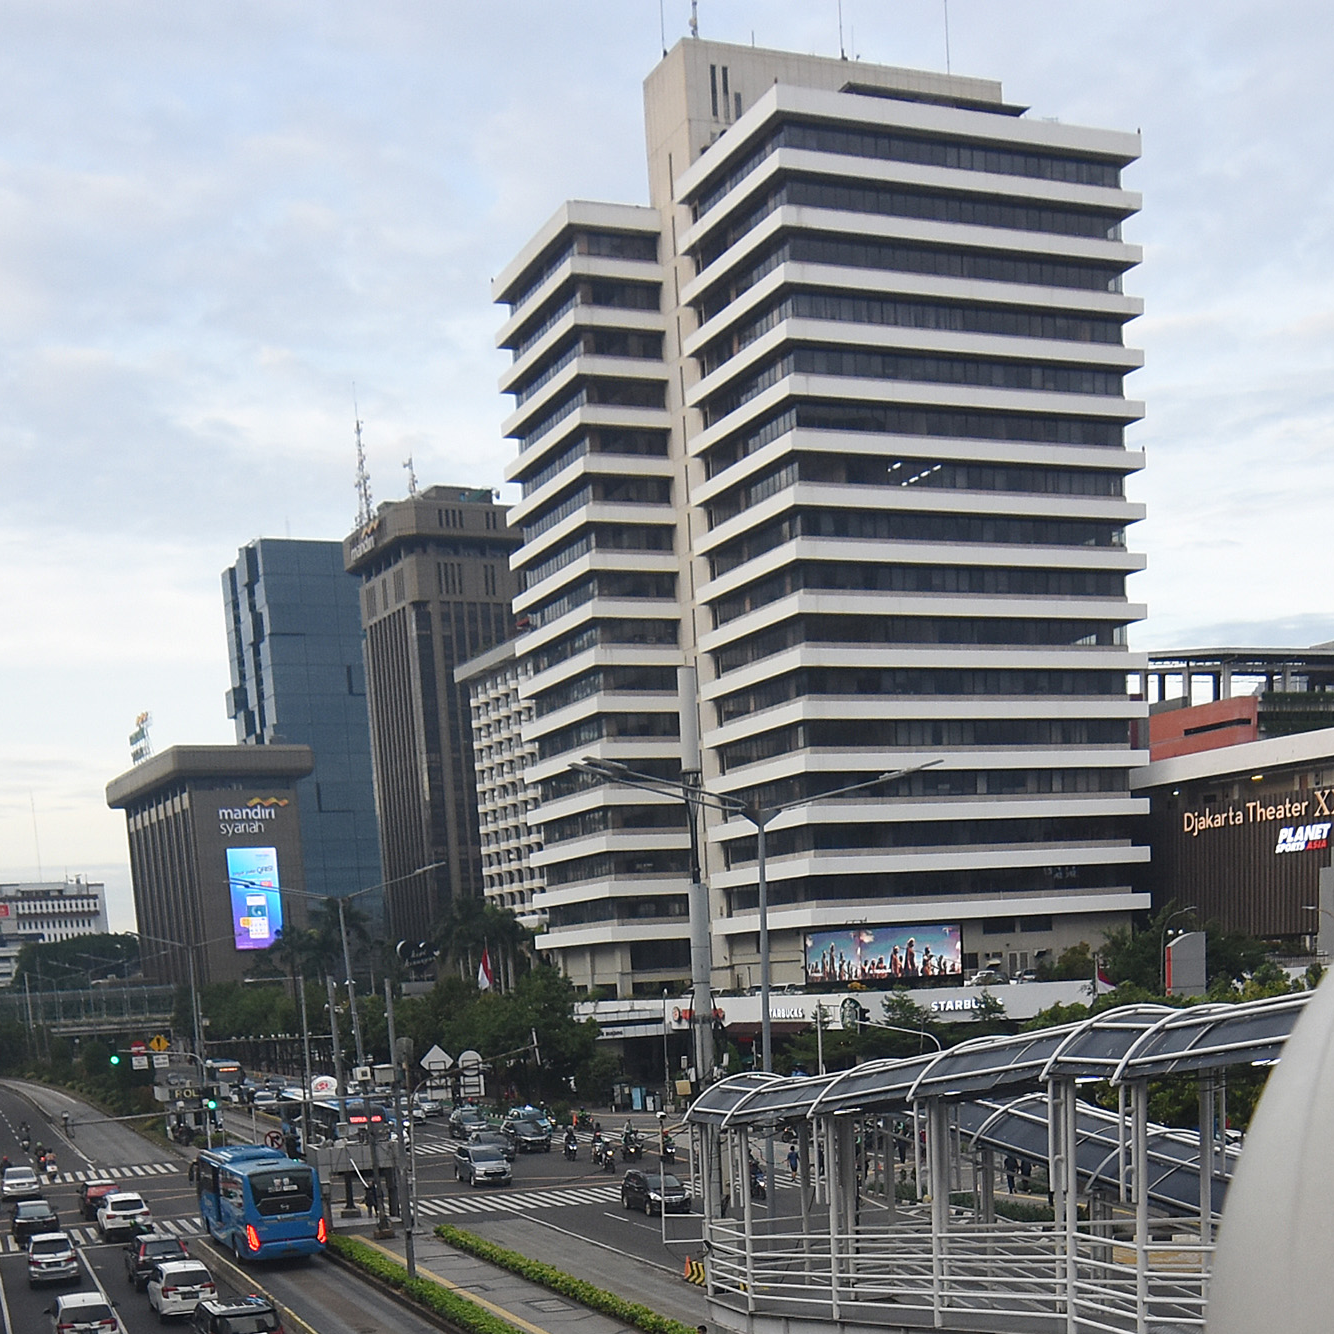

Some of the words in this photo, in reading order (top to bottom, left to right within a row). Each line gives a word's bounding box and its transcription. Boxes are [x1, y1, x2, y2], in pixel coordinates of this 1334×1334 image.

[219, 806, 275, 820] mandiri
[1183, 806, 1244, 836] Djakarta
[1245, 798, 1309, 823] Theater
[220, 821, 265, 836] syariah
[1278, 823, 1332, 844] PLANET
[1275, 841, 1306, 854] SPORTS
[1306, 839, 1328, 851] ASIA
